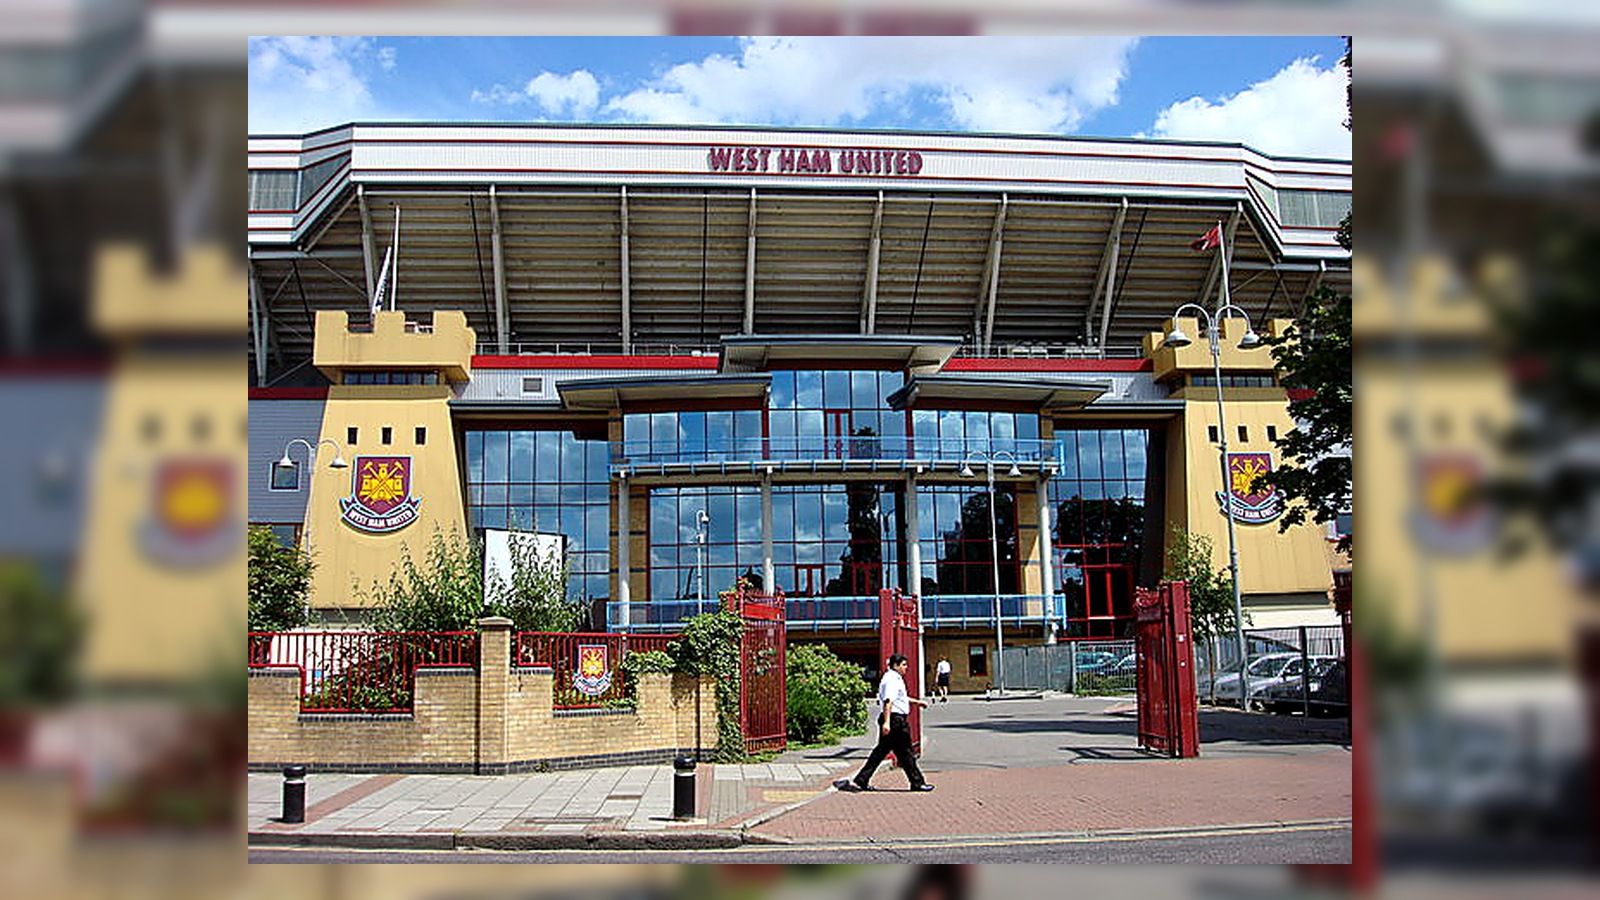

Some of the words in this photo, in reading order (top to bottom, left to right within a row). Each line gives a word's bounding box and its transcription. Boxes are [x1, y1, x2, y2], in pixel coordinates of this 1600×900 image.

[708, 147, 771, 171] WEST
[778, 149, 832, 173] HAM
[838, 150, 923, 175] UNITED
